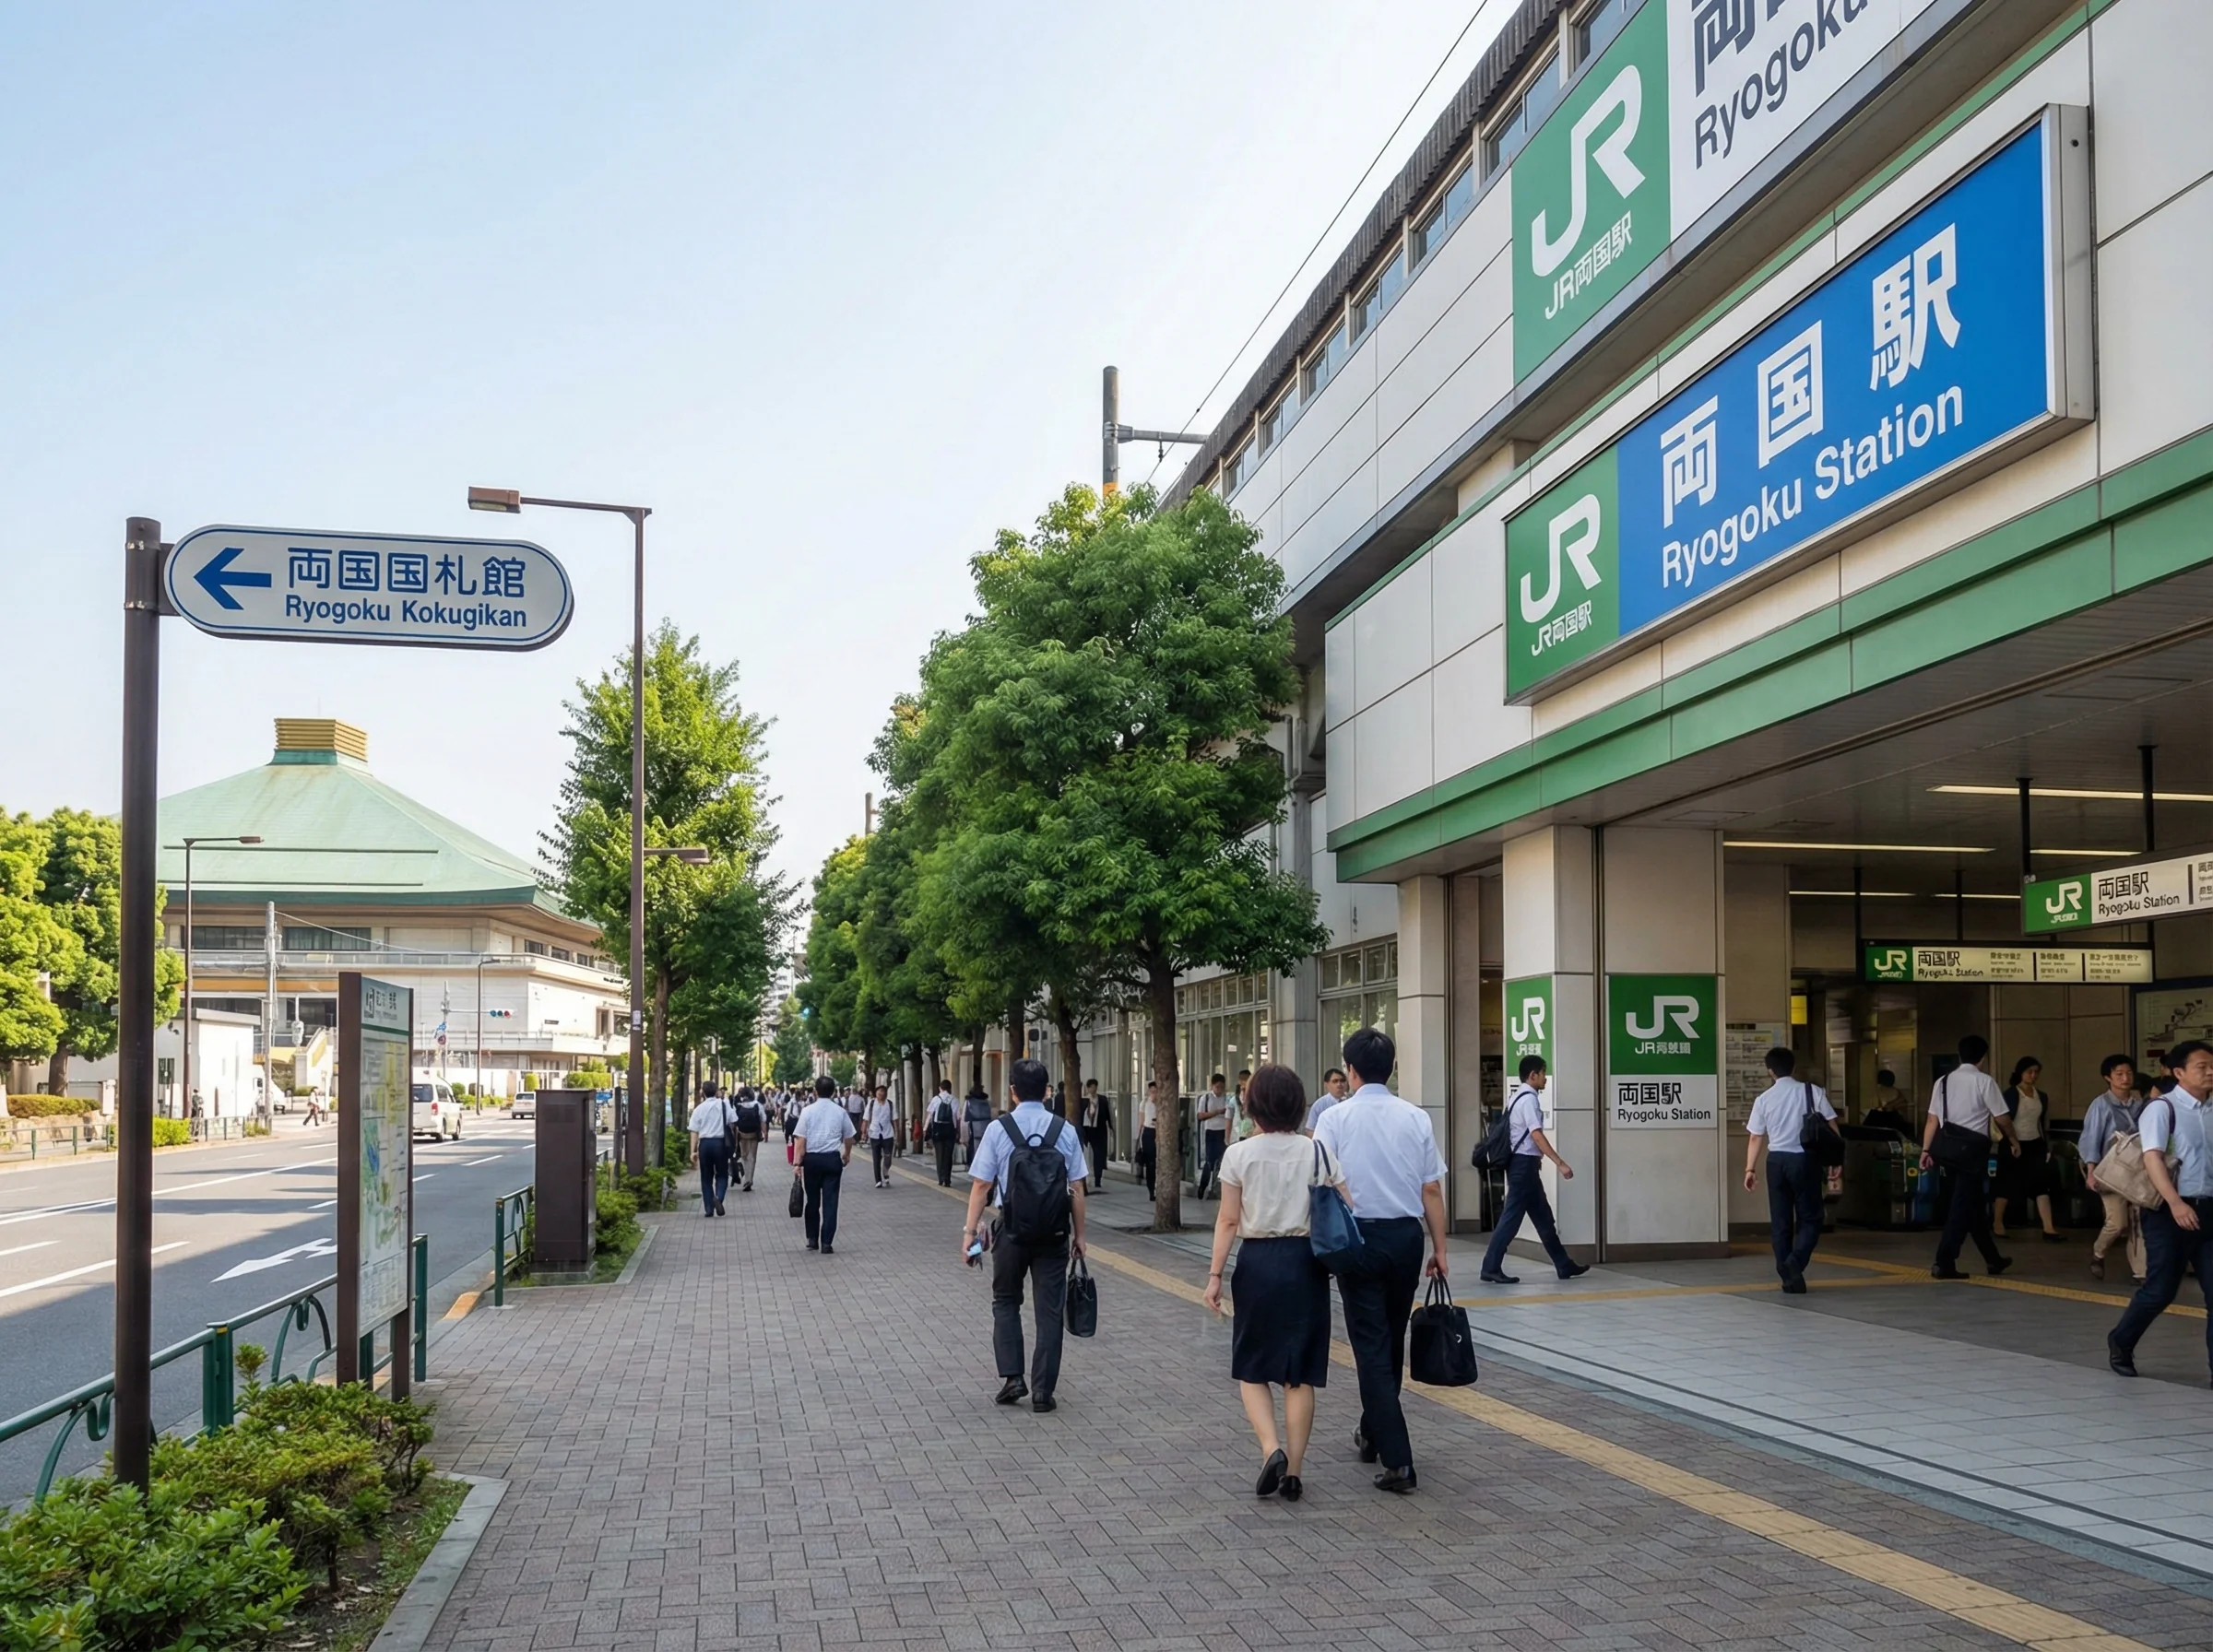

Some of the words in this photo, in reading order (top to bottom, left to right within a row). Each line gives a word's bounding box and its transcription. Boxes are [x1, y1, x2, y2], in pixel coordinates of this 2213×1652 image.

[1532, 65, 1646, 277] JR
[1544, 210, 1632, 320] JR両国駅
[1661, 223, 1961, 529] 両国駅
[1663, 478, 1804, 590] Ryogoku
[1816, 385, 1963, 501] Station
[288, 547, 526, 598] 両国国札館
[1521, 493, 1601, 623] JR
[286, 595, 390, 624] Ryogoku
[402, 599, 527, 631] Kokugikan
[2045, 881, 2083, 914] JR
[1875, 950, 1907, 971] JR
[1511, 997, 1545, 1042] JR
[1626, 996, 1700, 1039] JR
[1617, 1082, 1682, 1106] 両国駅
[1617, 1108, 1668, 1123] Ryogoku
